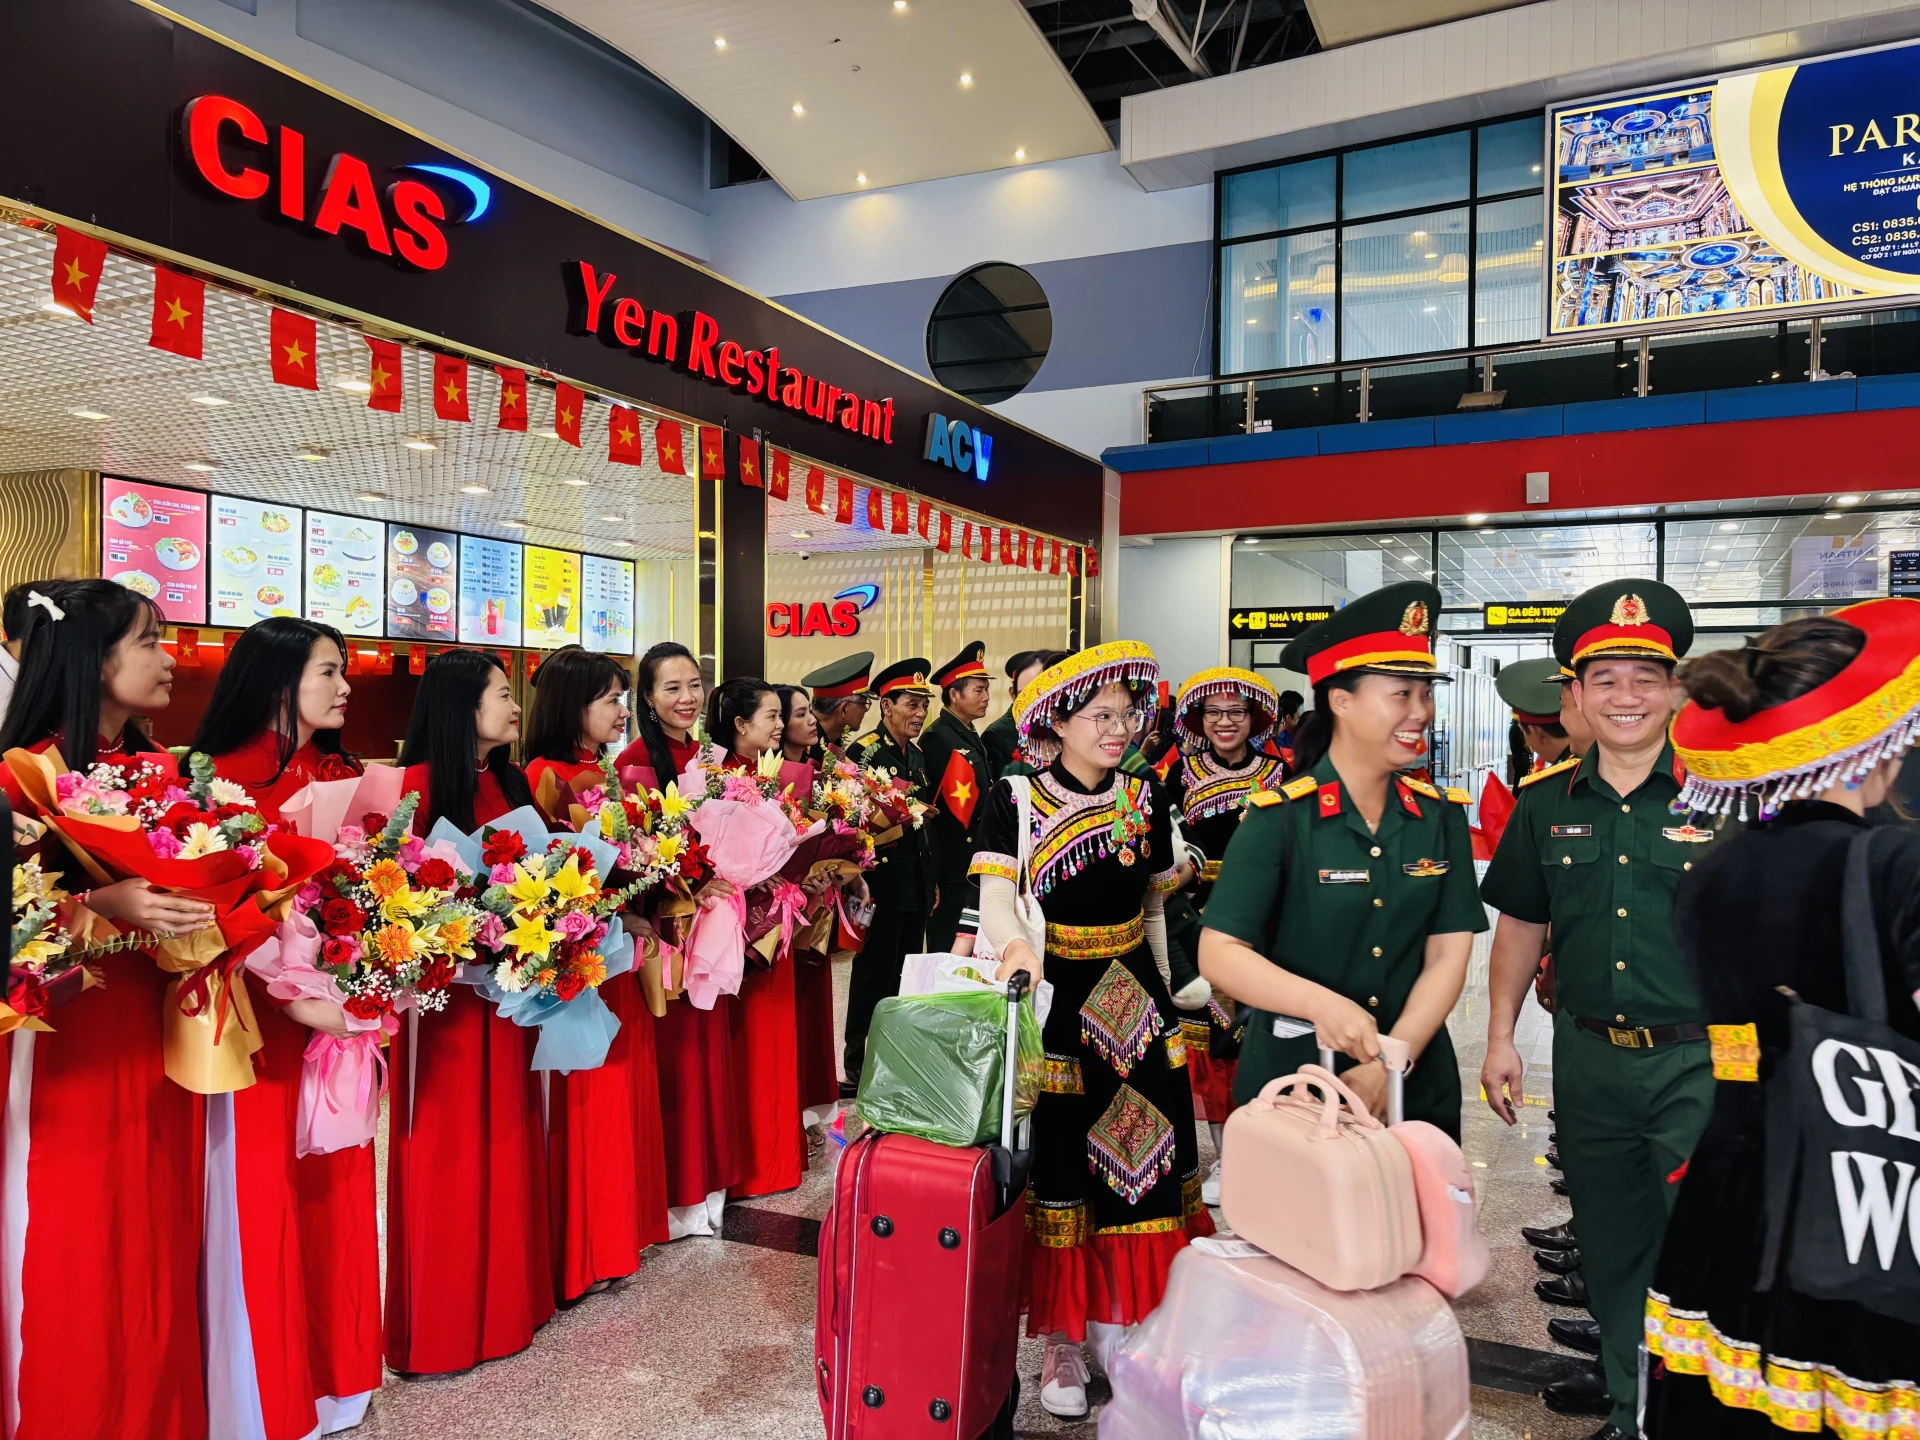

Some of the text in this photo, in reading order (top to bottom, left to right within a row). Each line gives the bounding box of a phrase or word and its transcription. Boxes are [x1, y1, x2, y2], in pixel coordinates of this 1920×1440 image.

[1828, 113, 1920, 157] PAR
[1902, 151, 1920, 167] K
[183, 95, 448, 270] CIAS
[1852, 221, 1879, 233] CS1:
[1852, 234, 1882, 246] CS2:
[578, 260, 895, 445] Yen Restaurant
[925, 412, 993, 482] ACV
[766, 601, 860, 637] CIAS
[1268, 611, 1290, 622] NHÀ
[1290, 611, 1304, 623] VỆ
[1508, 608, 1521, 617] GA
[1830, 1151, 1920, 1271] W
